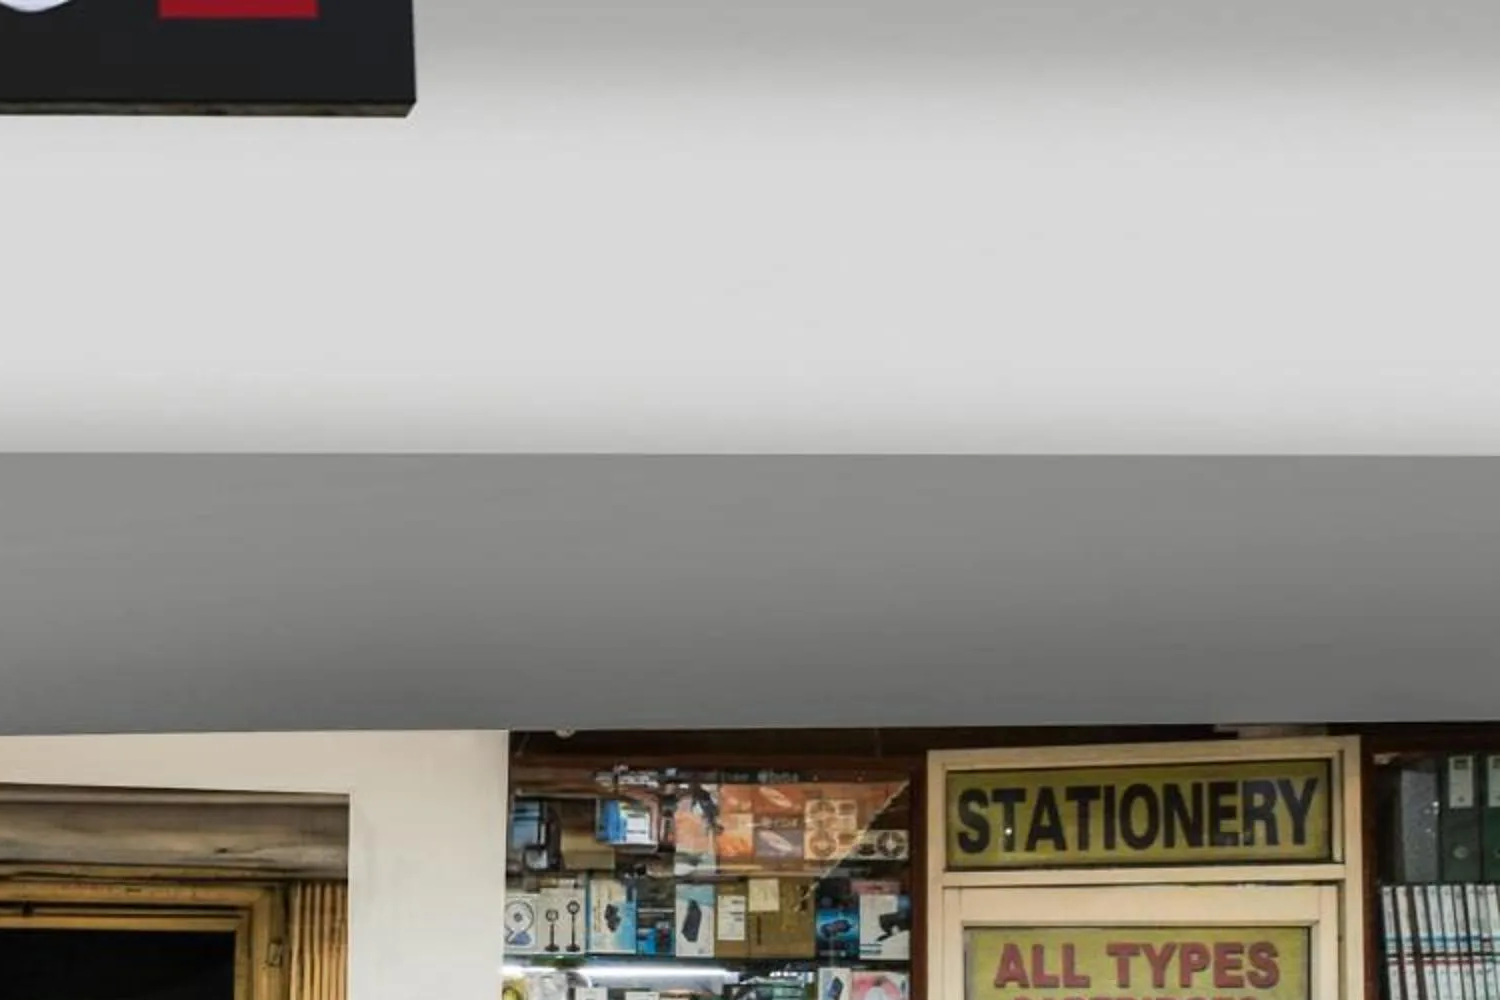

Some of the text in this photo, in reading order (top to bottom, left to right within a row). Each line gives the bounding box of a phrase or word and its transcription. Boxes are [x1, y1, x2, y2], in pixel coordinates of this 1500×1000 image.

[956, 777, 1318, 854] STATIONERY
[993, 941, 1280, 989] ALL TYPES
